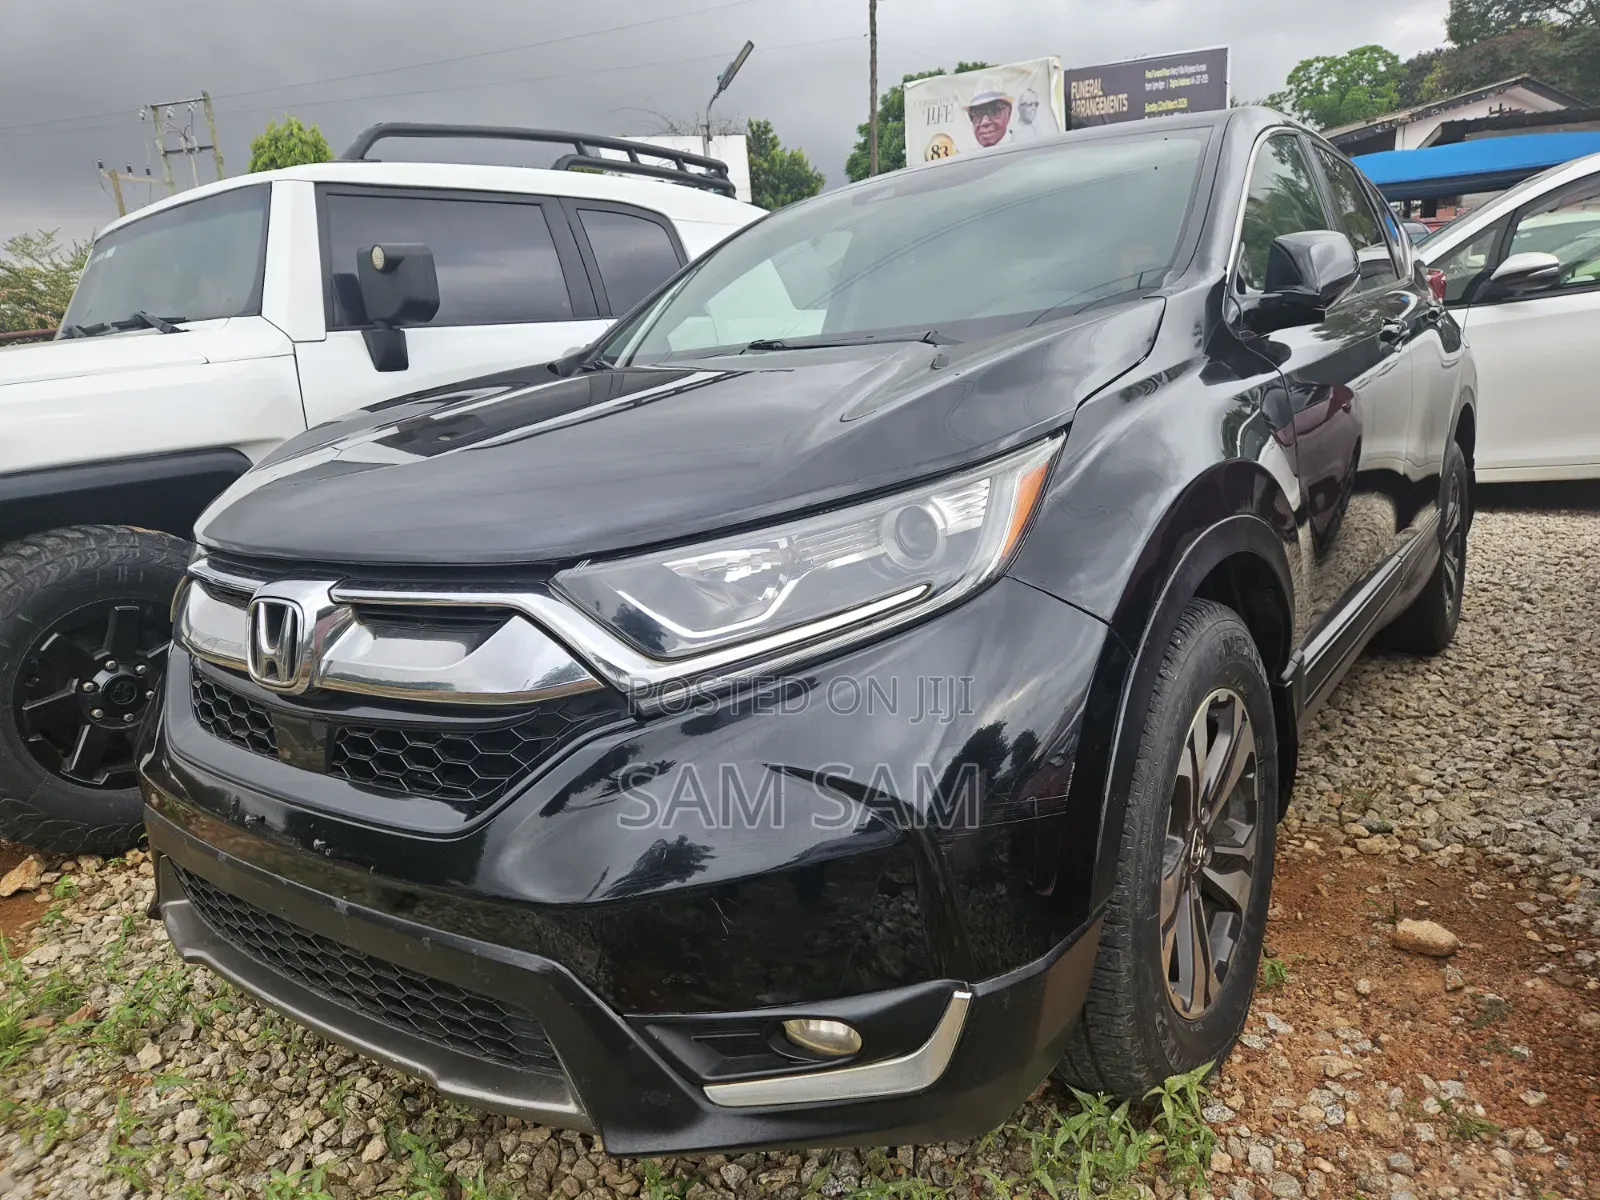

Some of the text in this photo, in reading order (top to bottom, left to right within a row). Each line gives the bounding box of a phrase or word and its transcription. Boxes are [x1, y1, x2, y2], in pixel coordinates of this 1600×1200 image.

[1071, 77, 1104, 99] FUNERAL
[927, 104, 954, 126] LIFE
[931, 144, 949, 161] 83
